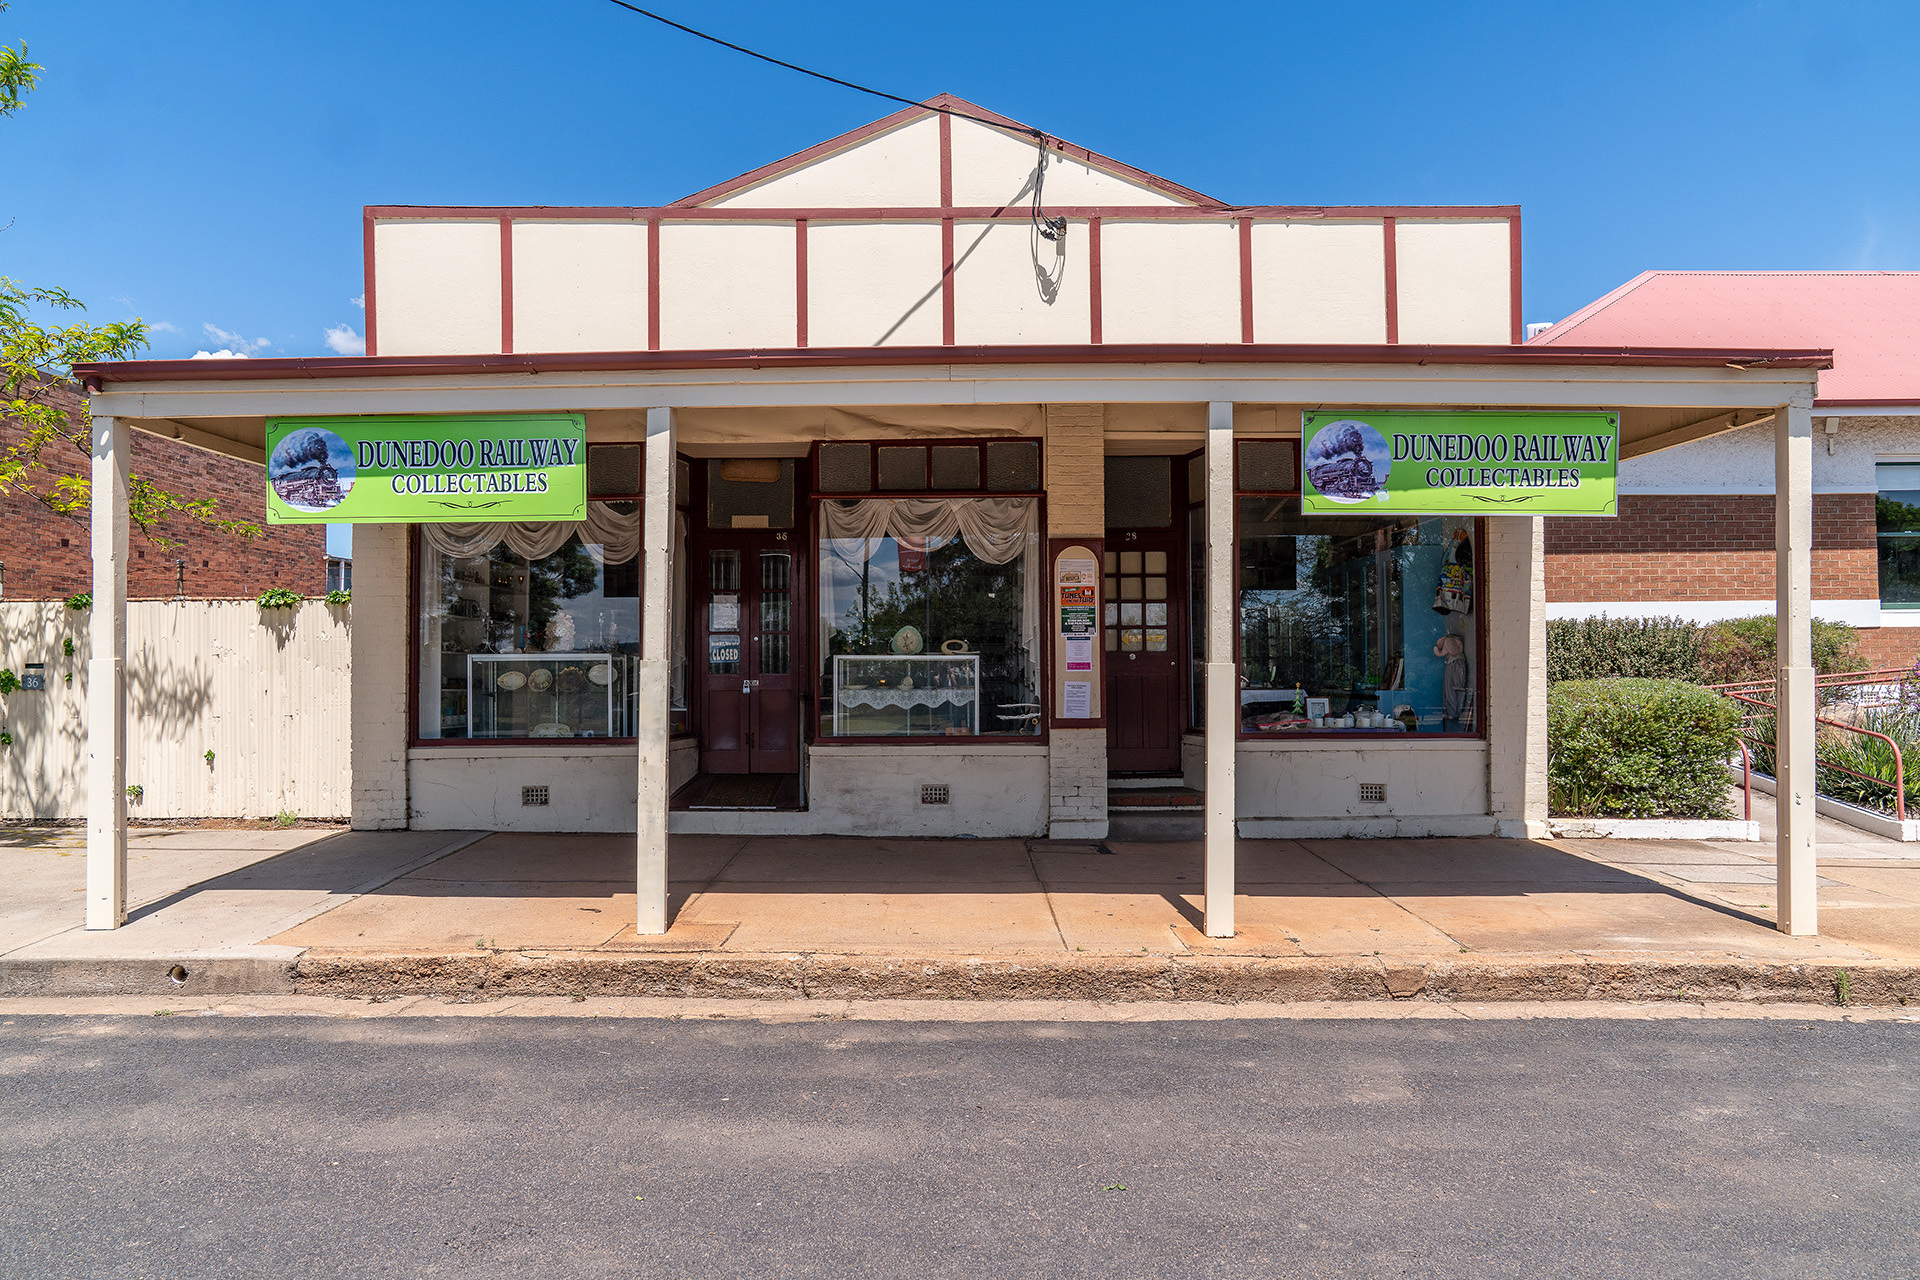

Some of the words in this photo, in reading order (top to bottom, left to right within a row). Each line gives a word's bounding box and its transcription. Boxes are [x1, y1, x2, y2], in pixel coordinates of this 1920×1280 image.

[357, 439, 475, 469] DUNEDOO
[478, 438, 580, 468] RAILWAY
[1392, 433, 1509, 463] DUNEDOO
[1512, 434, 1613, 463] RAILWAY
[391, 472, 549, 495] COLLECTABLES
[1425, 467, 1581, 489] COLLECTABLES
[776, 532, 788, 541] 36
[712, 648, 739, 660] CLOSED
[27, 677, 39, 688] 36
